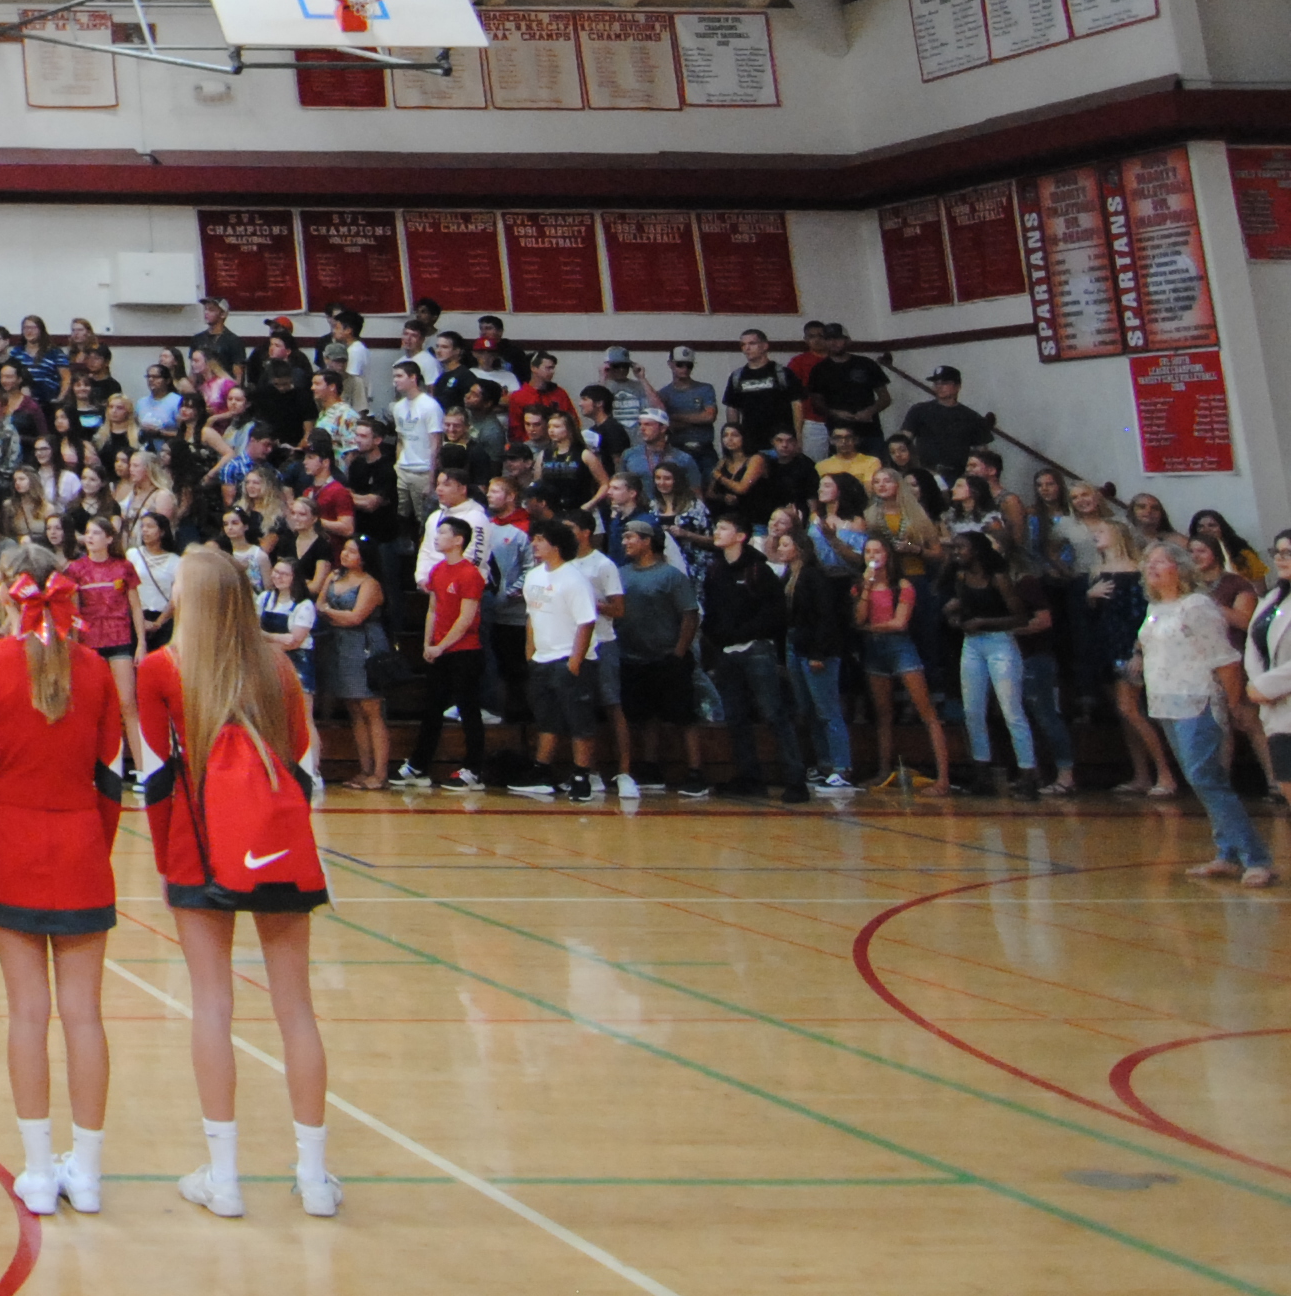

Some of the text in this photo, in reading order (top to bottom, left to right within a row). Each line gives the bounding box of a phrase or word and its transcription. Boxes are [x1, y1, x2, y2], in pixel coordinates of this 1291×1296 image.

[484, 13, 544, 22] BASEBALL
[577, 14, 639, 23] BASEBALL
[520, 32, 572, 42] CHAMPS
[587, 32, 662, 42] CHAMPIONS
[404, 214, 464, 223] VOLLEYBALL
[506, 214, 592, 225] SVL CHAMPS
[206, 225, 288, 236] CHAMPIONS
[310, 225, 391, 236] CHAMPIONS
[407, 223, 494, 233] SVL CHAMPS
[514, 226, 586, 236] 1991 VARSITY
[611, 223, 685, 233] 1992 VARSITY
[737, 223, 784, 233] VOLLEYBALL
[223, 236, 273, 245] VOLLEYBALL
[328, 236, 377, 245] VOLLEYBALL
[518, 237, 586, 247] VOLLEYBALL
[618, 233, 682, 243] VOLLEYBALL
[1107, 195, 1144, 348] SPARTANS
[1024, 212, 1057, 357] SPARTANS
